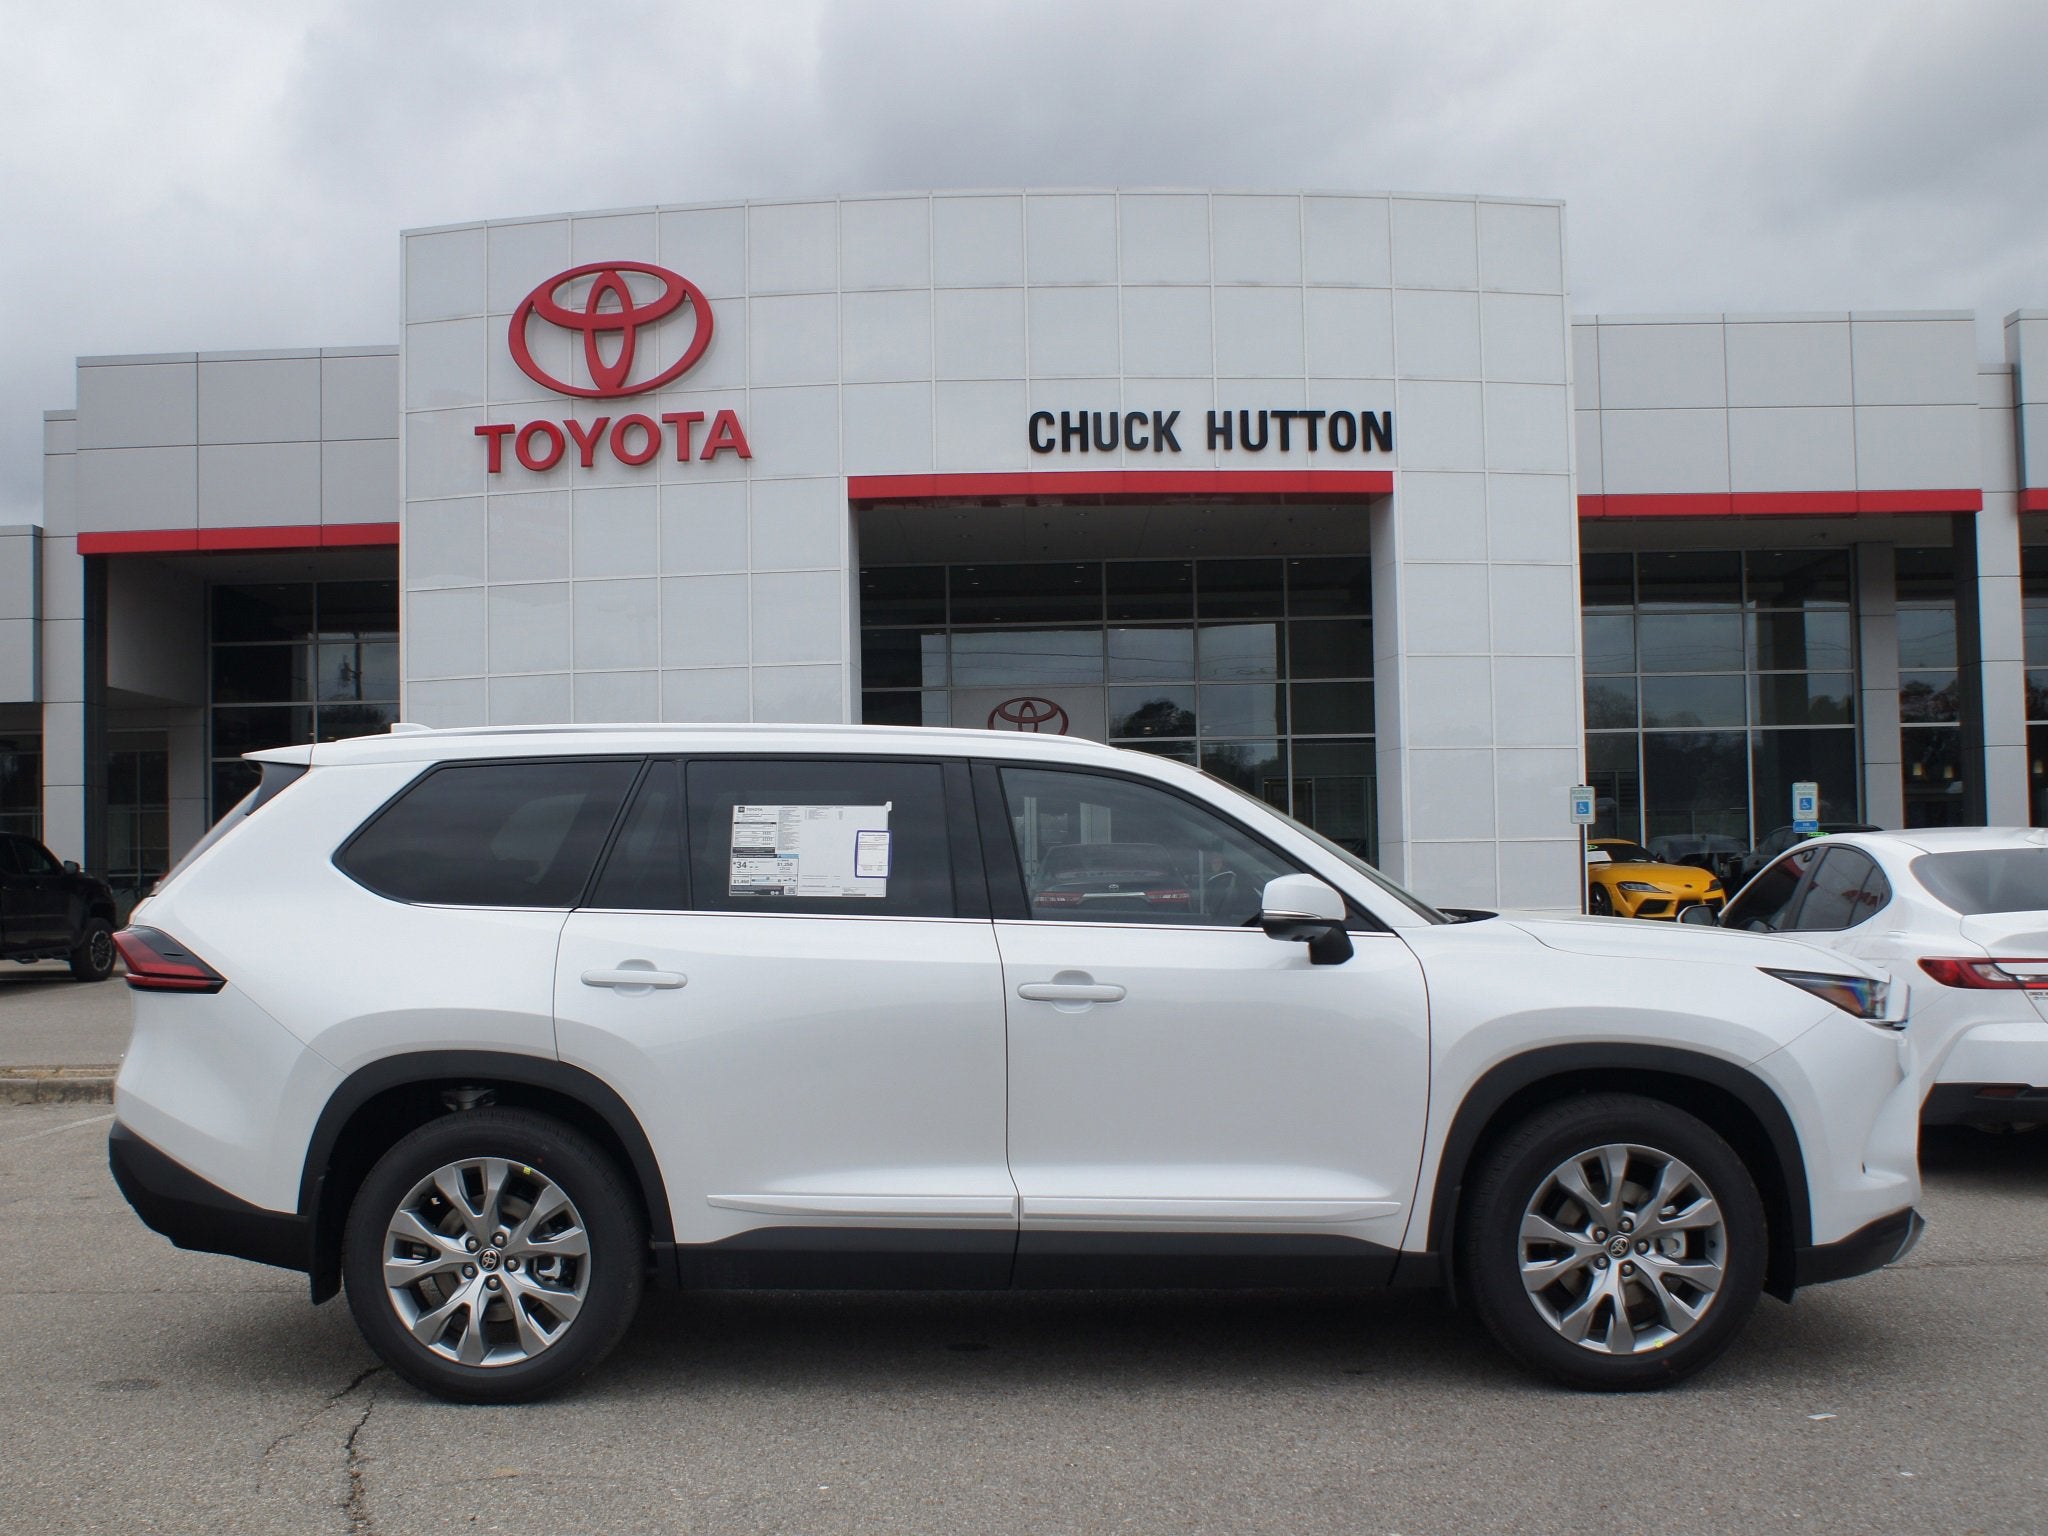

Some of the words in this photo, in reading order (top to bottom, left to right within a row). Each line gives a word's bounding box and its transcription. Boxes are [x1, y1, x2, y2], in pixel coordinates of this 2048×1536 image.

[474, 409, 753, 474] TOYOTA
[1028, 410, 1182, 453] CHUCK
[1206, 410, 1394, 453] HUTTON
[736, 861, 747, 869] 34
